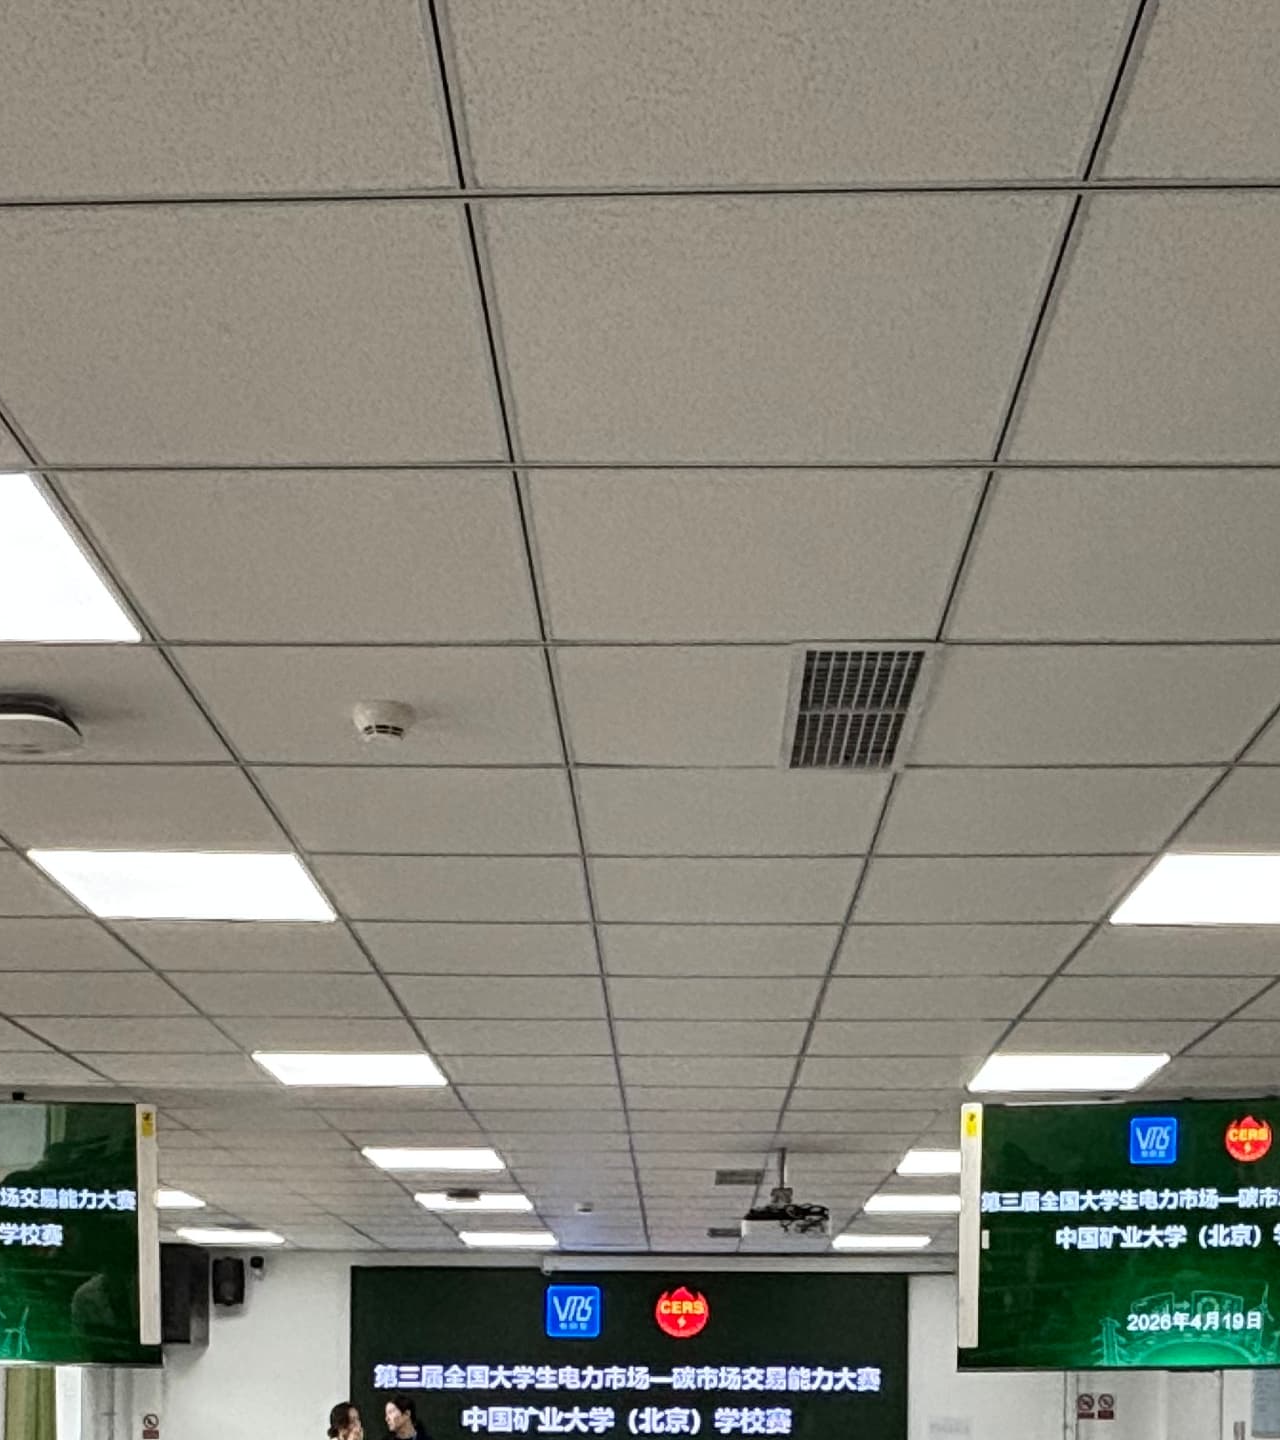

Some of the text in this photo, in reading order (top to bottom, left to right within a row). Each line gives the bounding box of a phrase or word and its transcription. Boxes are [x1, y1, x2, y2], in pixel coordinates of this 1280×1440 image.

[660, 1300, 705, 1315] CERS
[1126, 1311, 1262, 1332] 2026年4月19日
